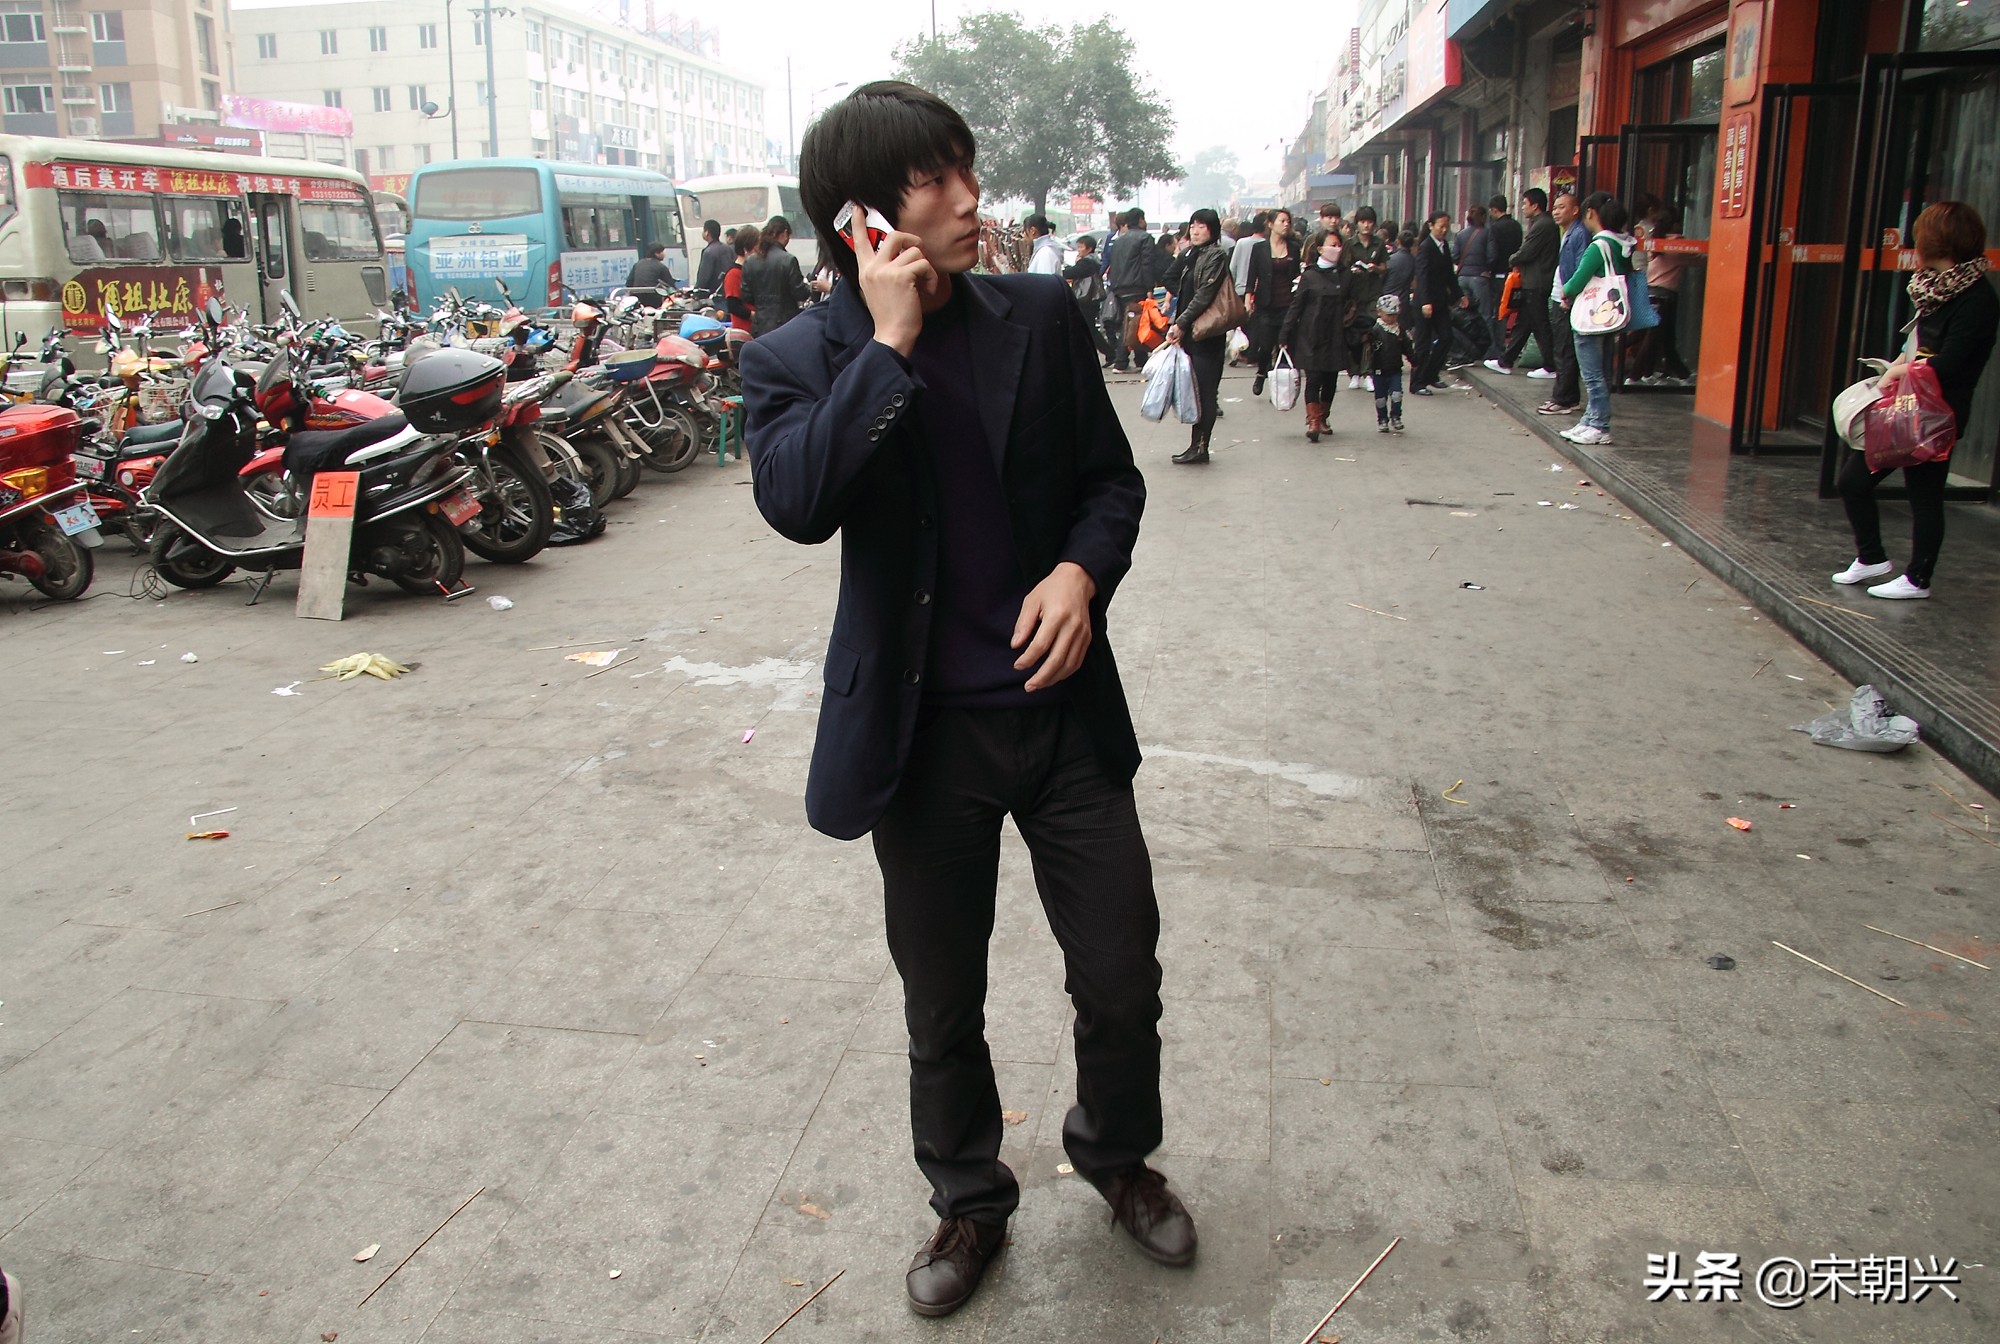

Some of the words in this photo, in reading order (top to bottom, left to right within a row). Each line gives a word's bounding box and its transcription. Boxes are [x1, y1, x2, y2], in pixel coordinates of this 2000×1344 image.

[51, 166, 160, 189] 酒后莫开车
[236, 175, 300, 197] 祝您平安
[435, 250, 523, 269] 亚洲铝业
[97, 277, 193, 318] 酒祖杜康
[313, 479, 355, 510] 员工
